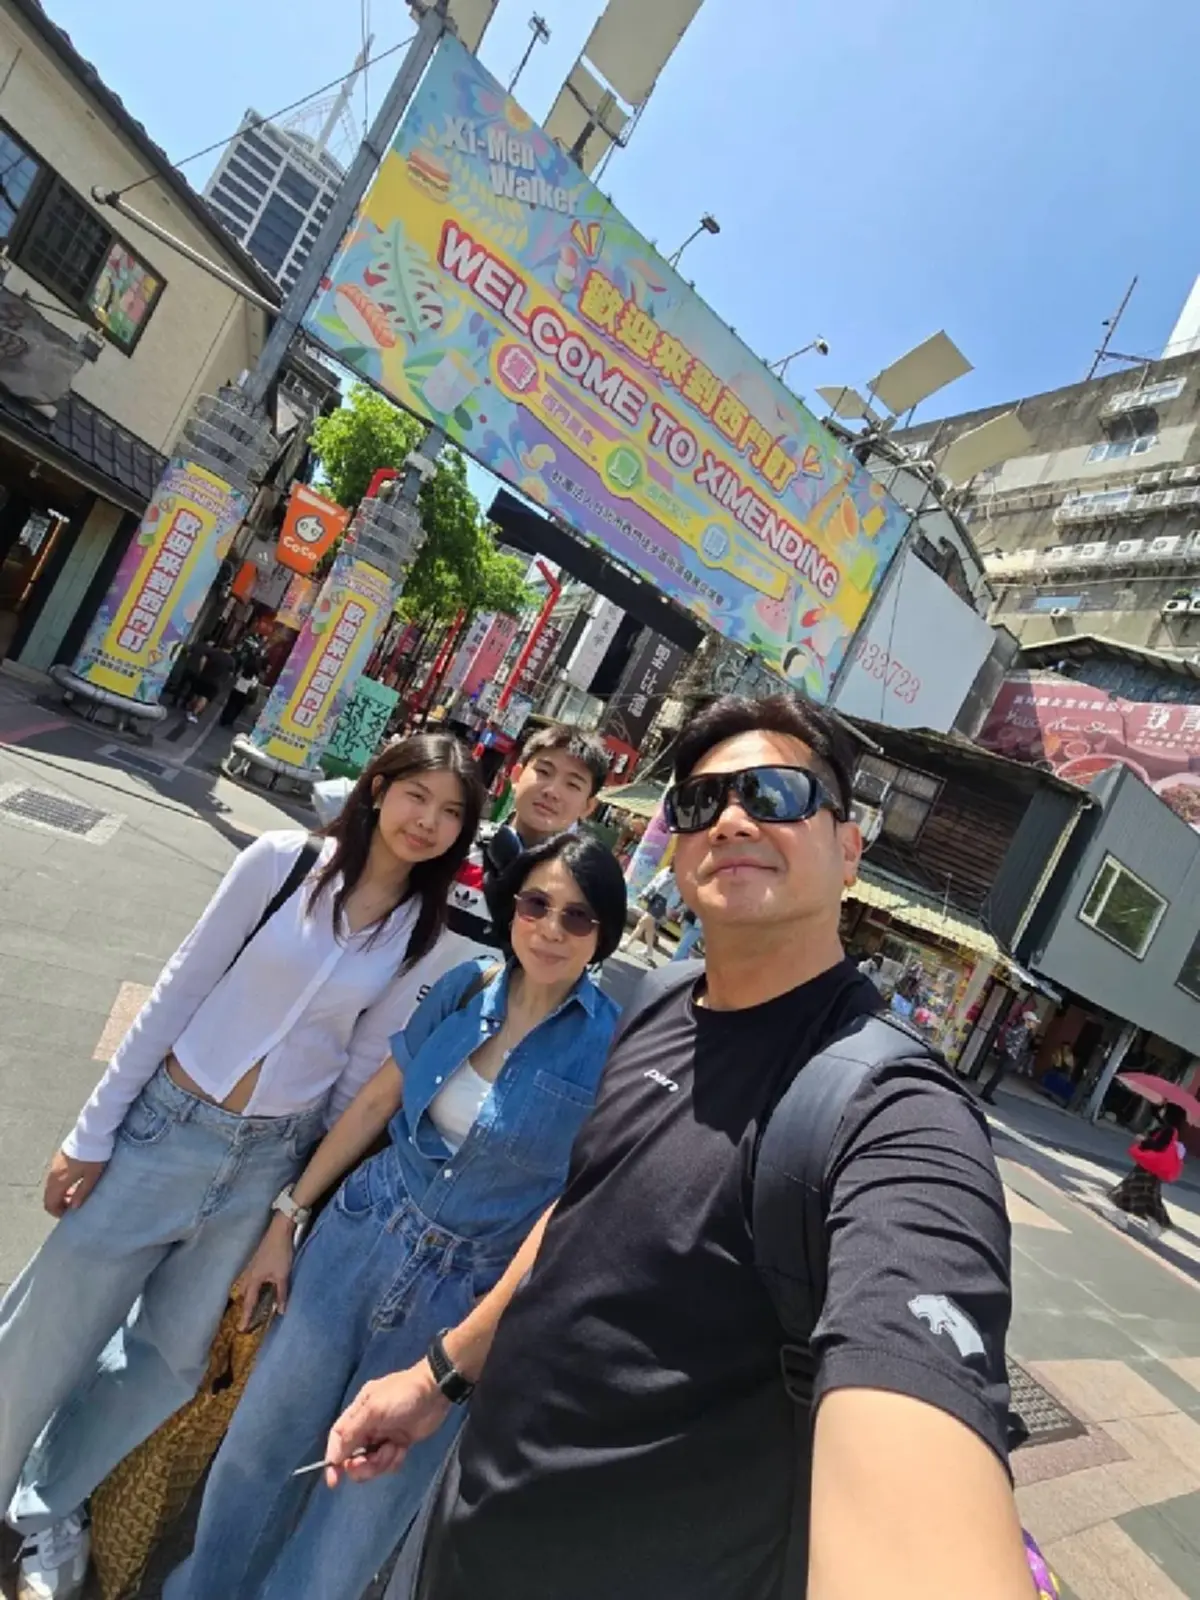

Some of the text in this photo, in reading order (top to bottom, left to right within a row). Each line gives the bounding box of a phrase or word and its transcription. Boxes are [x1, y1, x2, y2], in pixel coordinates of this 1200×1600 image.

[442, 113, 535, 171] Xi-Men
[489, 161, 580, 217] Walker
[441, 225, 838, 597] WELCOME TO XIMENDING
[580, 269, 798, 495] 歡迎來到西門町
[283, 536, 317, 560] CoCo
